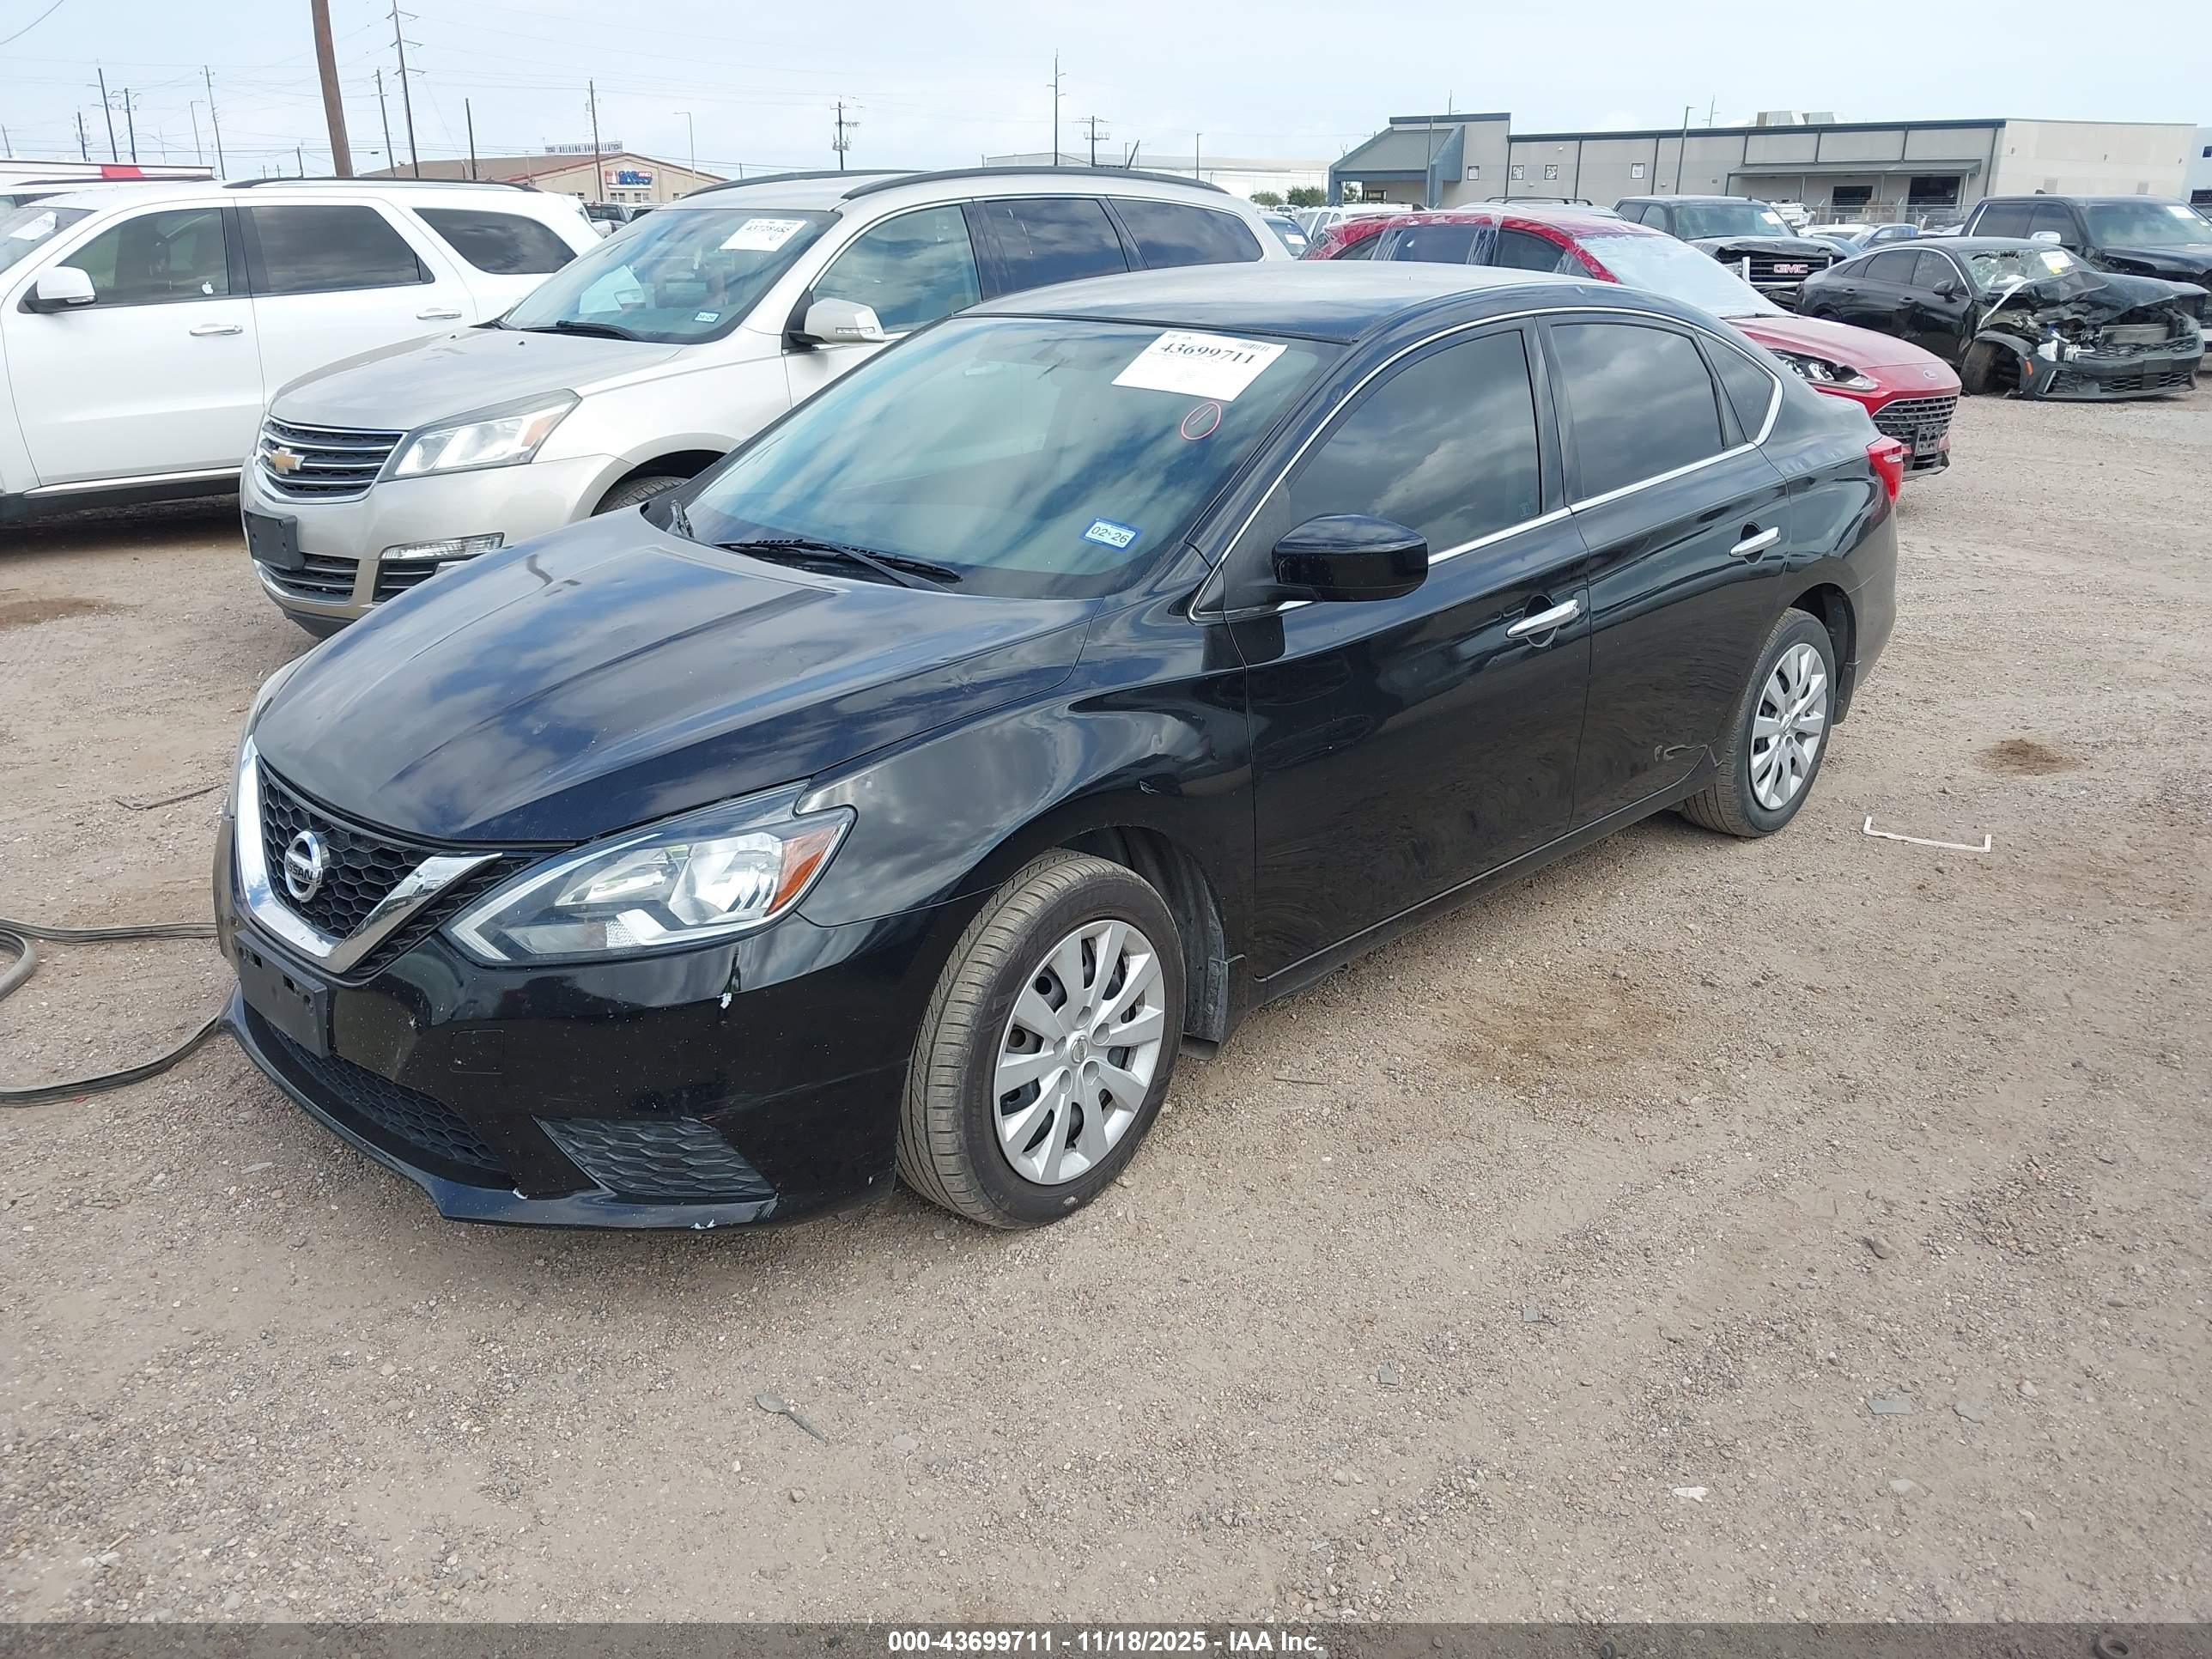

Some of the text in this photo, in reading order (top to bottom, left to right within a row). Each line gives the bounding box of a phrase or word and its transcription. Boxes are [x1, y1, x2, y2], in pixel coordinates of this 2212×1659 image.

[1773, 264, 1808, 274] GMC
[1161, 343, 1255, 364] 43699711
[287, 858, 313, 881] SSAN
